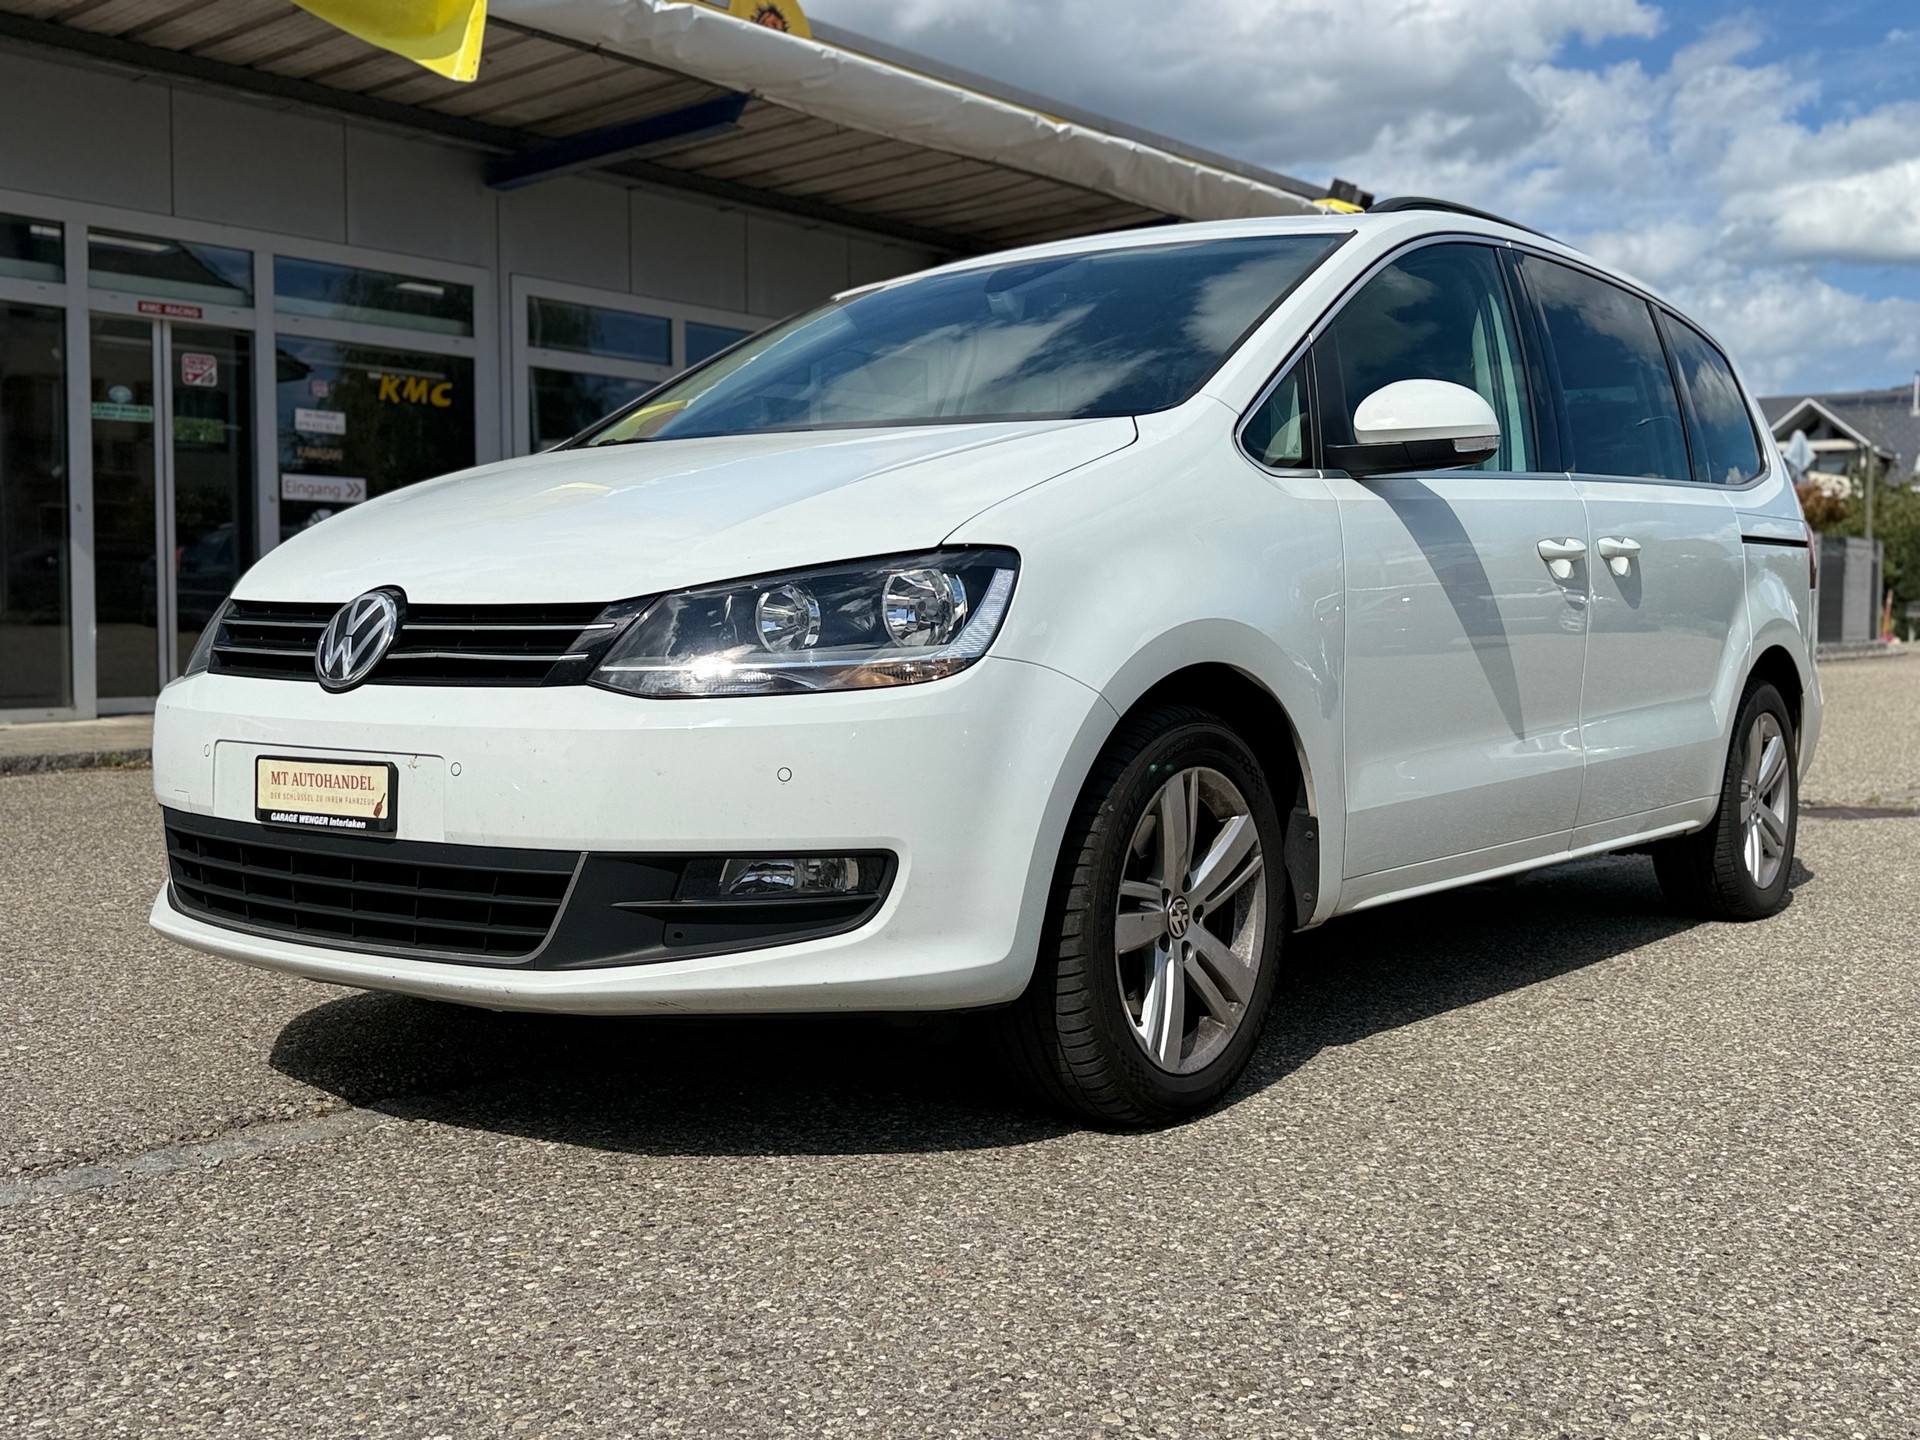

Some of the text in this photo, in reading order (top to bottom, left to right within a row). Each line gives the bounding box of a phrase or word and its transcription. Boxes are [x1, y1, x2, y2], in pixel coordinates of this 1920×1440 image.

[164, 304, 200, 318] RACING
[378, 374, 453, 408] KMC
[284, 479, 341, 497] Eingang
[270, 771, 375, 791] MT AUTOHANDEL
[270, 791, 281, 800] DER
[283, 791, 314, 803] SCHLÜSSEL
[316, 794, 323, 802] ZU
[325, 795, 343, 804] IHREM
[270, 812, 367, 829] GARAGE WENGER Interlaken
